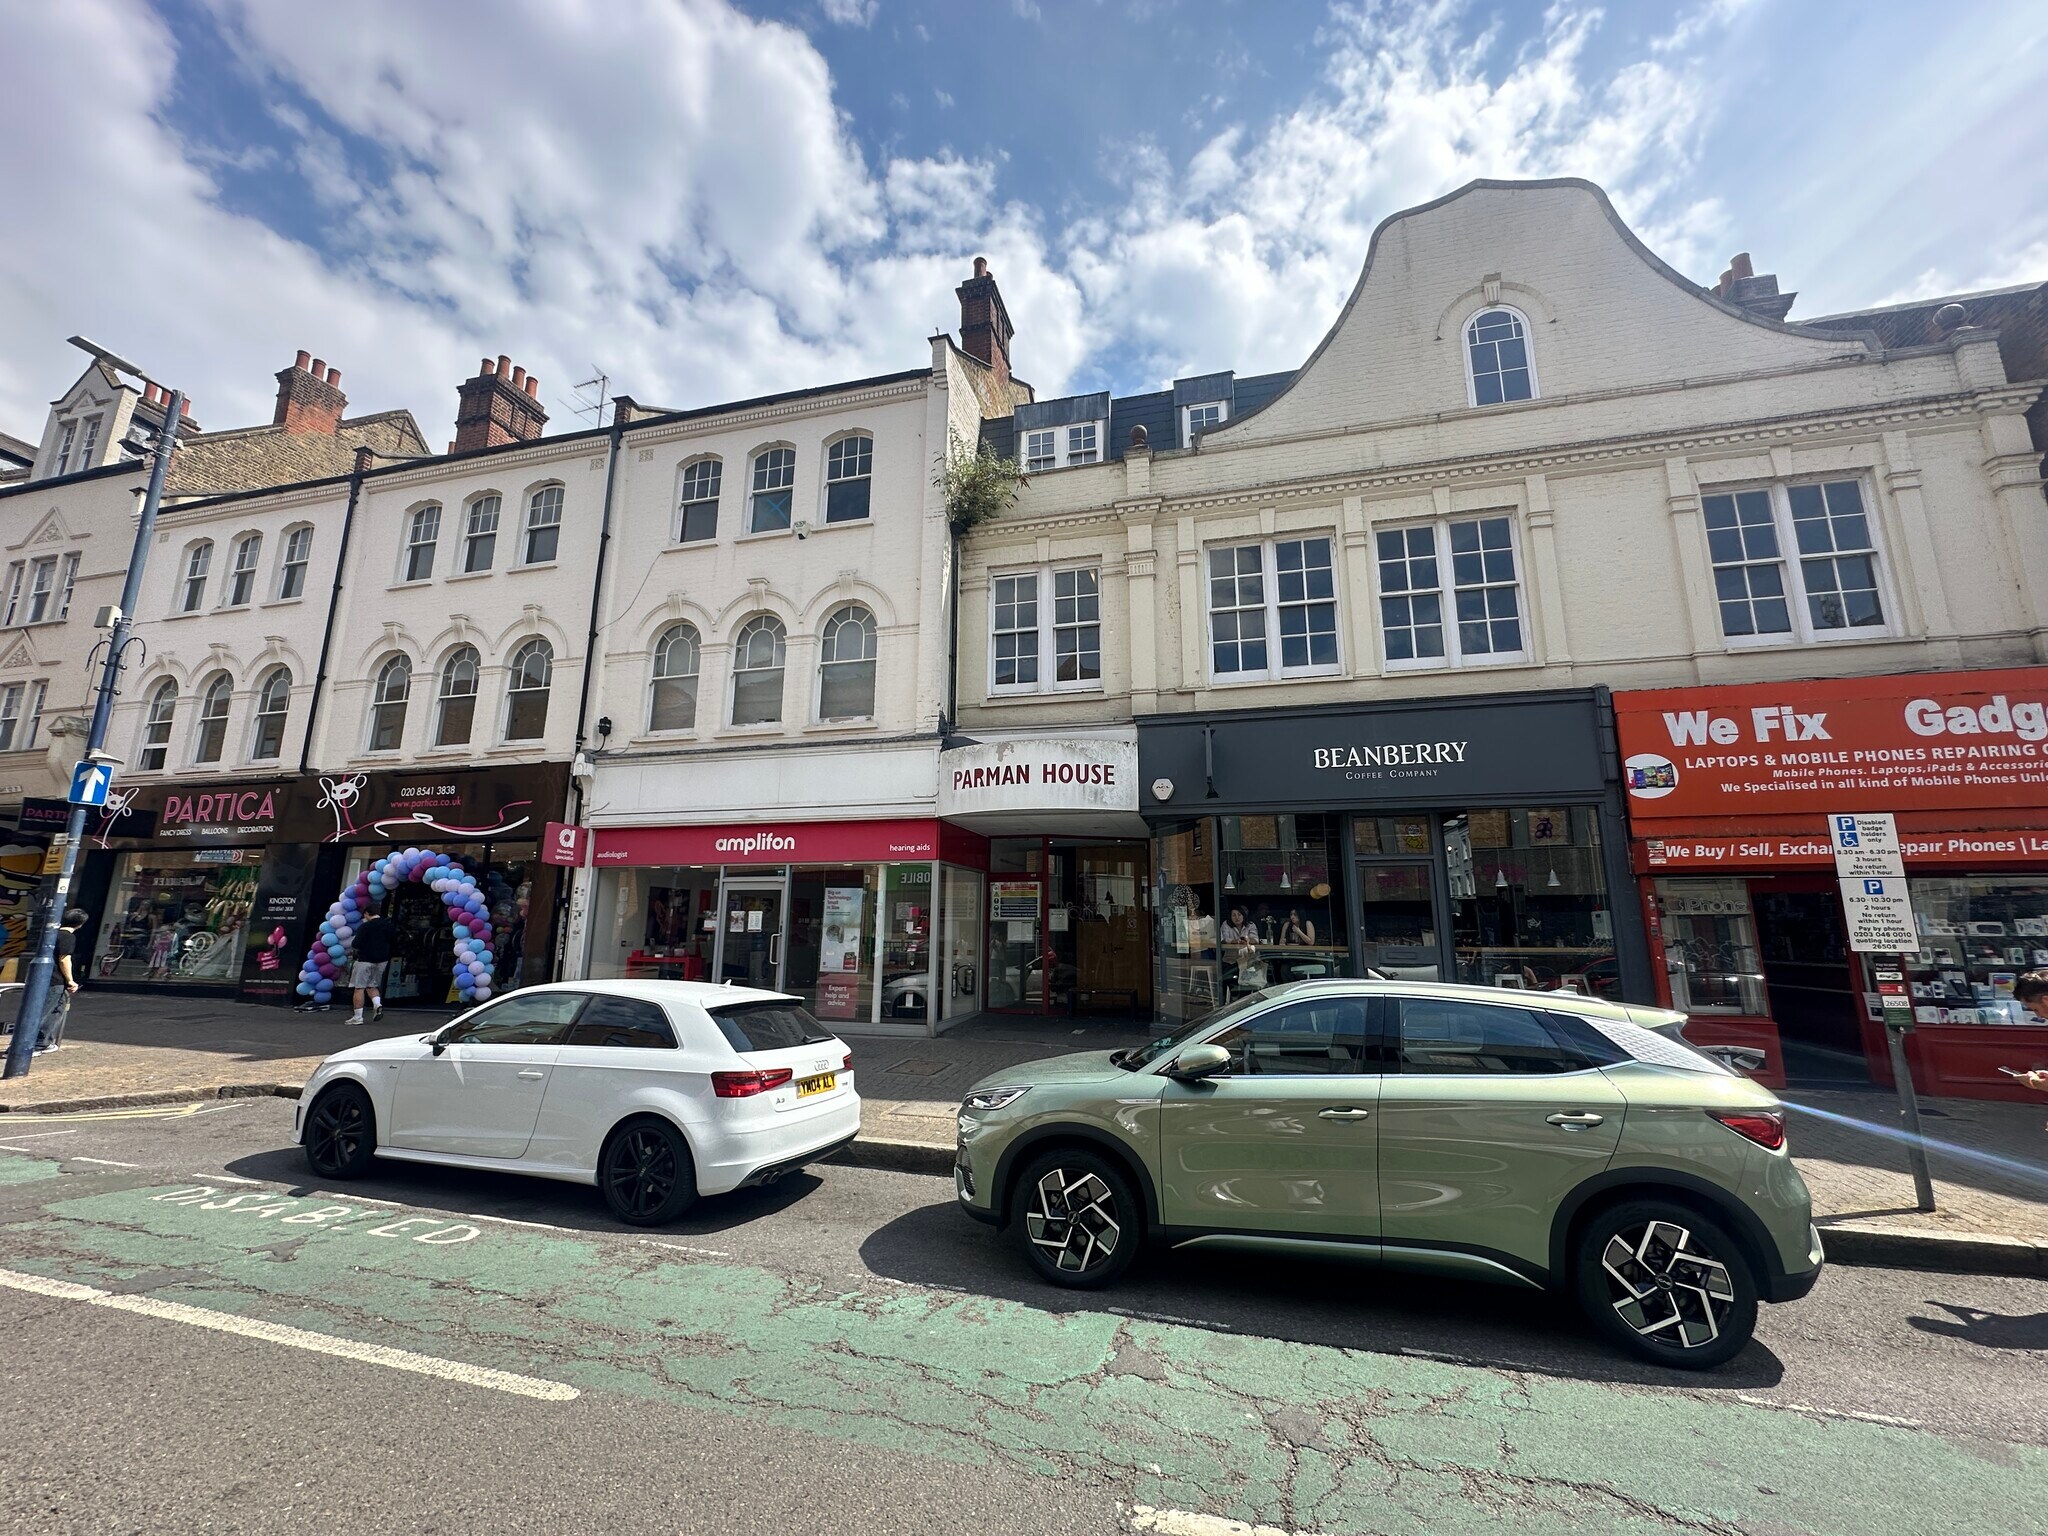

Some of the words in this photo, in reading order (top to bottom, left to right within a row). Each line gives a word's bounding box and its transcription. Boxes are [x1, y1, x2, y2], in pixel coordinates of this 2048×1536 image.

[1662, 711, 1739, 747] We
[1750, 706, 1833, 743] Fix
[1904, 695, 2048, 741] Gadg
[1314, 741, 1468, 769] BEANBERRY
[1685, 755, 1759, 769] LAPTOPS
[1764, 754, 1776, 766] &
[1782, 751, 1849, 765] MOBILE
[1854, 748, 1926, 763] PHONES
[1931, 744, 2036, 760] REPAIRING
[953, 764, 1030, 790] PARMAN
[1042, 763, 1115, 786] HOUSE
[1773, 767, 1815, 778] Mobile
[1966, 762, 1975, 771] &
[401, 788, 416, 797] 020
[416, 786, 434, 796] 8541
[436, 785, 456, 795] 3838
[1721, 783, 1741, 793] We
[1744, 779, 1818, 794] Specialised
[1821, 779, 1834, 789] in
[1838, 778, 1855, 789] all
[1859, 776, 1890, 788] kind
[1893, 776, 1908, 787] of
[1911, 775, 1961, 787] Mobile
[1964, 773, 2017, 785] Phones
[163, 791, 275, 823] PARTICA
[390, 796, 462, 809] www.partica.co.uk
[160, 829, 176, 837] FANCY
[176, 828, 192, 836] DRESS
[201, 827, 229, 835] BALLOONS
[237, 825, 274, 834] DECORATIONS
[597, 851, 628, 859] audiologist
[889, 843, 915, 854] hearing
[916, 843, 931, 851] aids
[715, 832, 795, 855] amplifon
[1665, 845, 1690, 858] We
[1694, 844, 1726, 860] Buy
[1729, 844, 1734, 857] /
[1739, 843, 1774, 858] Sell,
[1900, 842, 1943, 856] epair
[1948, 838, 2016, 852] Phones
[269, 897, 297, 905] KINGSTON
[824, 992, 838, 1000] help
[828, 985, 847, 993] Expert
